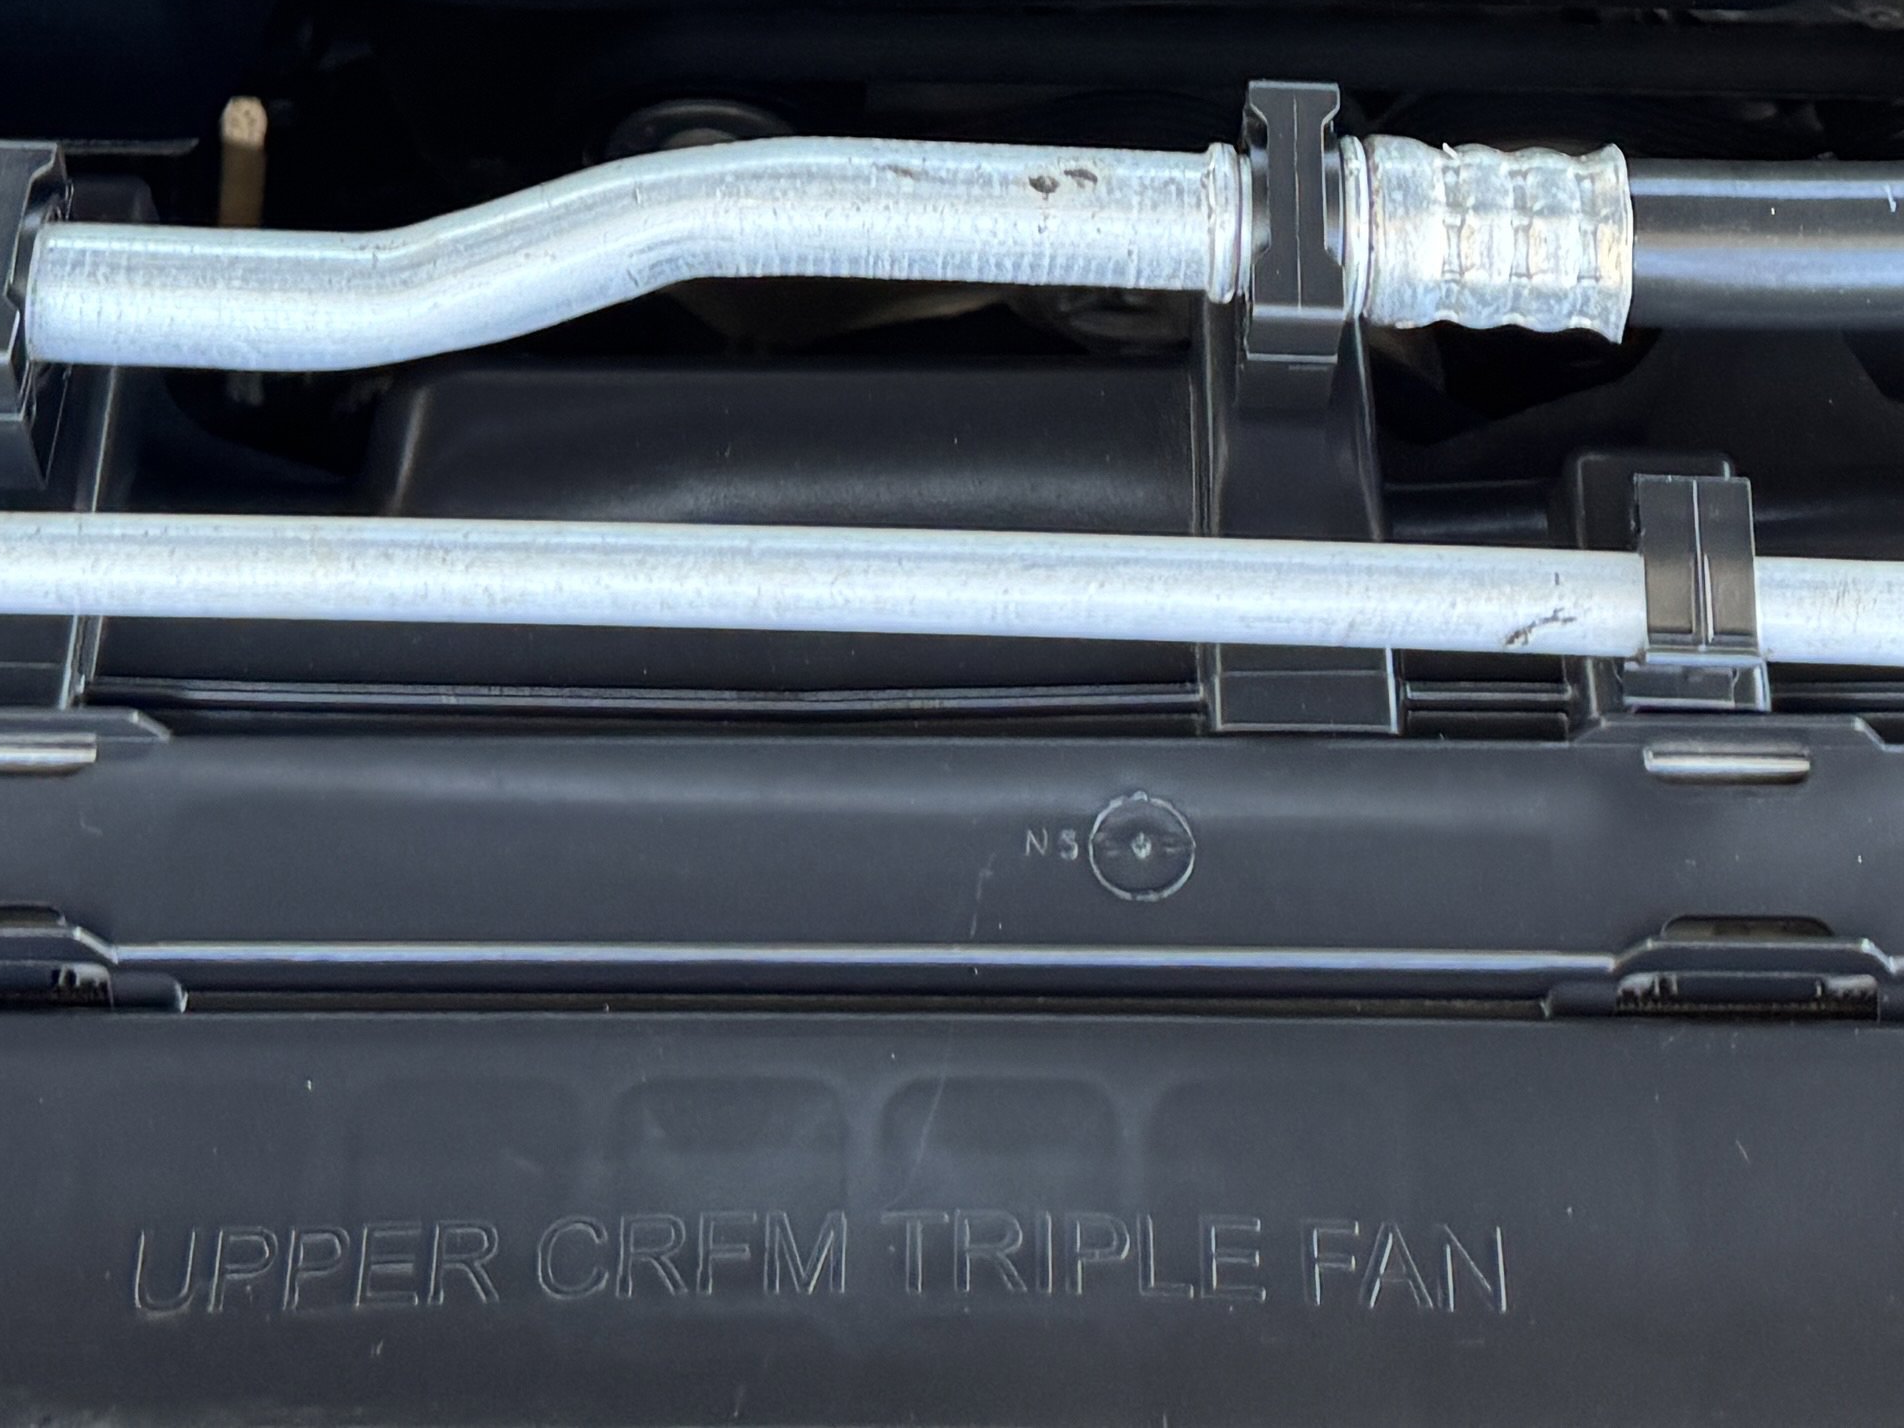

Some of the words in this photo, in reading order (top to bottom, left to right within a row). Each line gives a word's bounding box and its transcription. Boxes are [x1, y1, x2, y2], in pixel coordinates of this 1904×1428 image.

[133, 1219, 503, 1317] UPPER
[534, 1209, 849, 1301] CRFM
[886, 1209, 1270, 1308] TRIPLE
[1302, 1217, 1512, 1315] FAN
